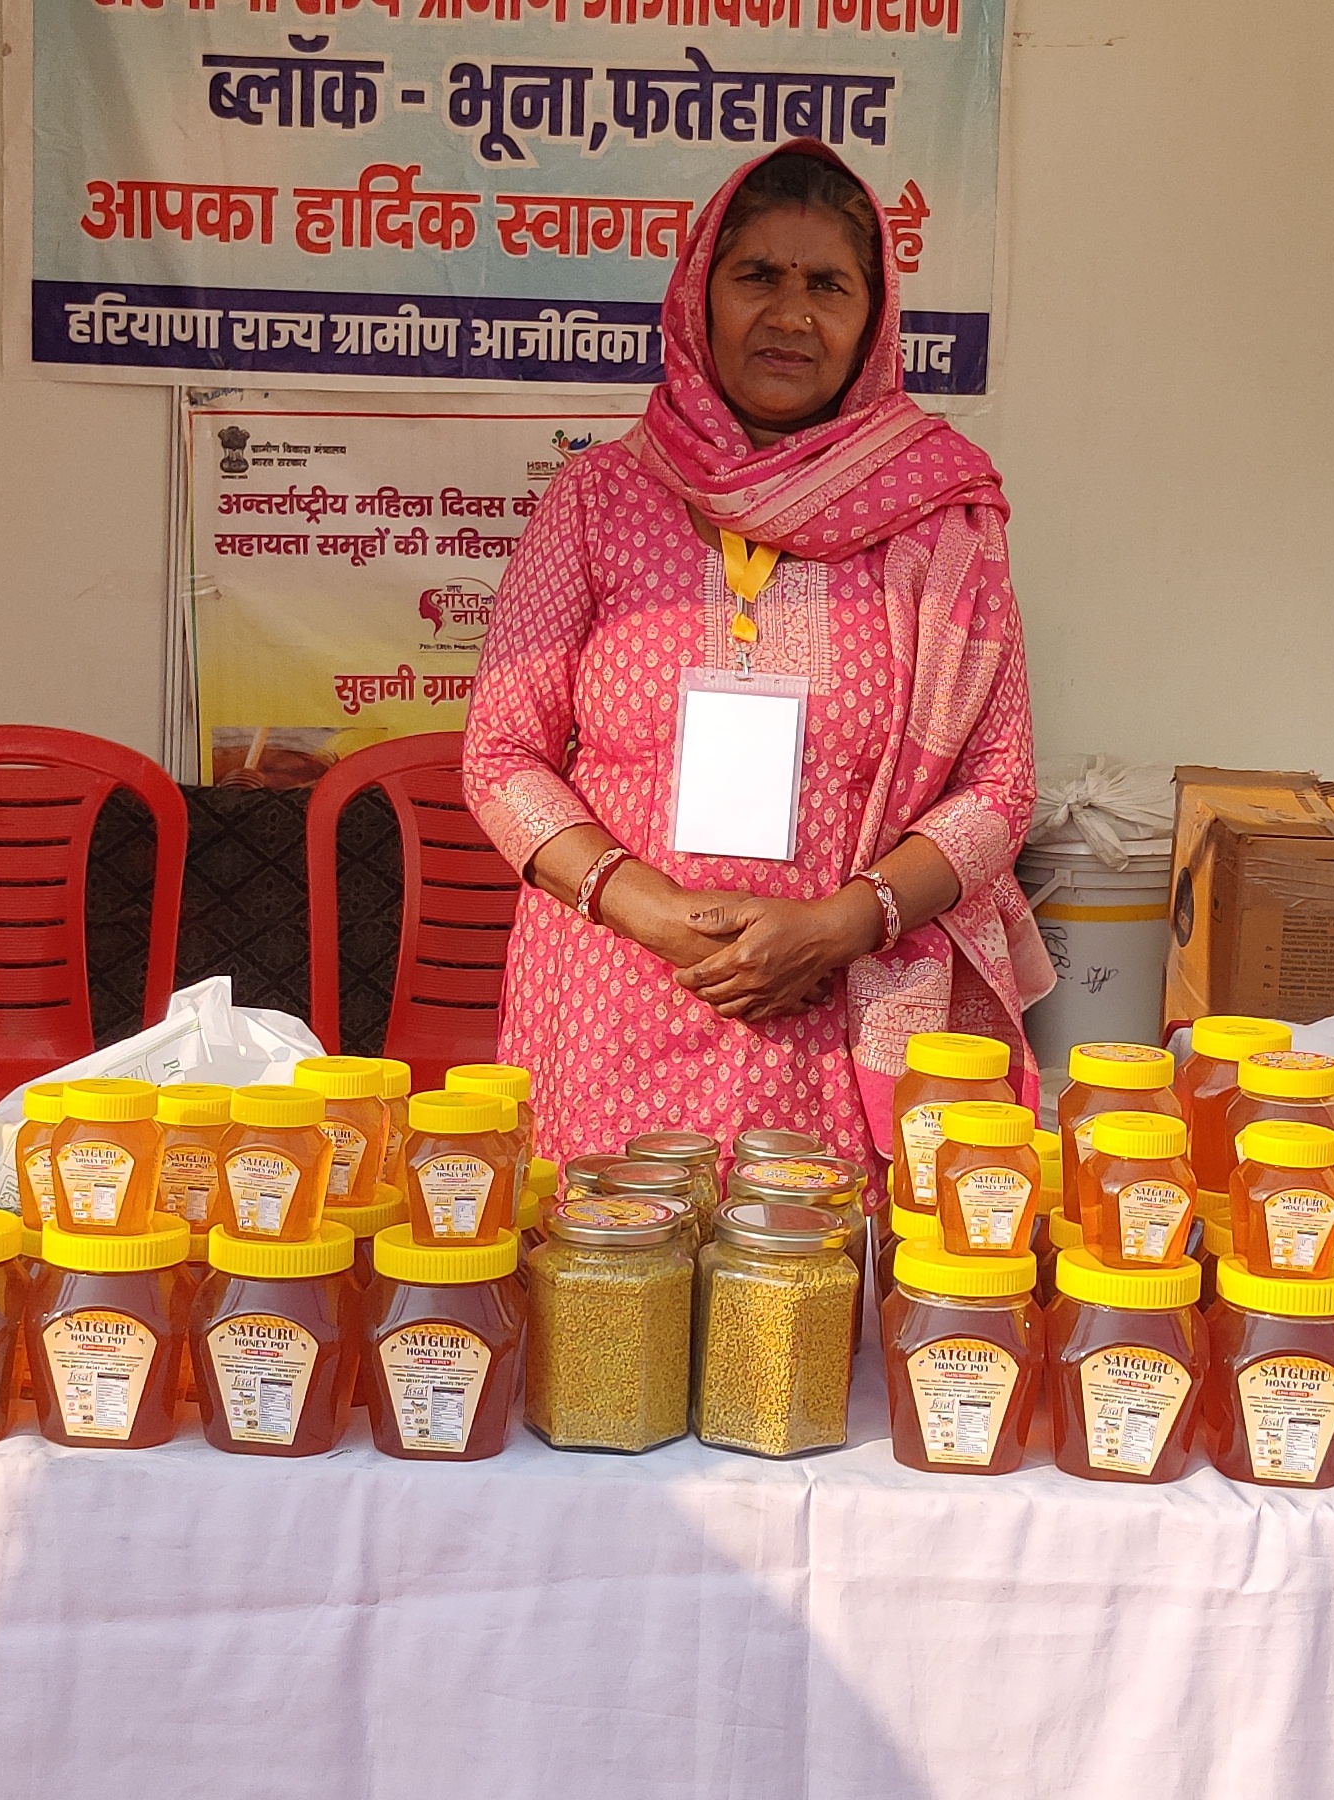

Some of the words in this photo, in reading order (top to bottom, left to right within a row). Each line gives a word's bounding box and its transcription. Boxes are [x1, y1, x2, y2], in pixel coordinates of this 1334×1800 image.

[204, 33, 384, 129] ब्लॉक
[80, 179, 278, 245] आपका
[294, 163, 475, 253] हार्दिक
[497, 191, 695, 261] स्वागत
[64, 291, 222, 366] हरियाणा
[230, 307, 322, 359] राज्य
[332, 304, 460, 363] ग्रामीण
[471, 311, 651, 368] आजीविका
[252, 458, 274, 467] भारत
[355, 486, 433, 518] महिला
[440, 488, 505, 518] दिवस
[215, 532, 309, 556] सहायता
[317, 527, 391, 567] समूहों
[393, 527, 427, 556] की
[450, 605, 491, 625] नारी
[334, 664, 416, 715] सुहानी
[64, 1320, 137, 1337] SATGURU
[227, 1323, 299, 1341] SATGURU
[71, 1335, 103, 1344] HONEY
[107, 1335, 127, 1345] POT
[235, 1339, 267, 1349] HONEY
[270, 1340, 290, 1350] POT
[399, 1333, 471, 1350] SATGURU
[406, 1348, 439, 1358] HONEY
[442, 1349, 462, 1359] POT
[928, 1349, 999, 1364] SATGURU
[935, 1362, 967, 1371] HONEY
[970, 1363, 989, 1372] POT
[1102, 1354, 1174, 1375] SATGURU
[1260, 1365, 1331, 1381] SATGURU
[1108, 1368, 1139, 1380] HONEY
[1143, 1372, 1163, 1383] POT
[1265, 1379, 1297, 1389] HONEY
[1302, 1381, 1321, 1391] POT
